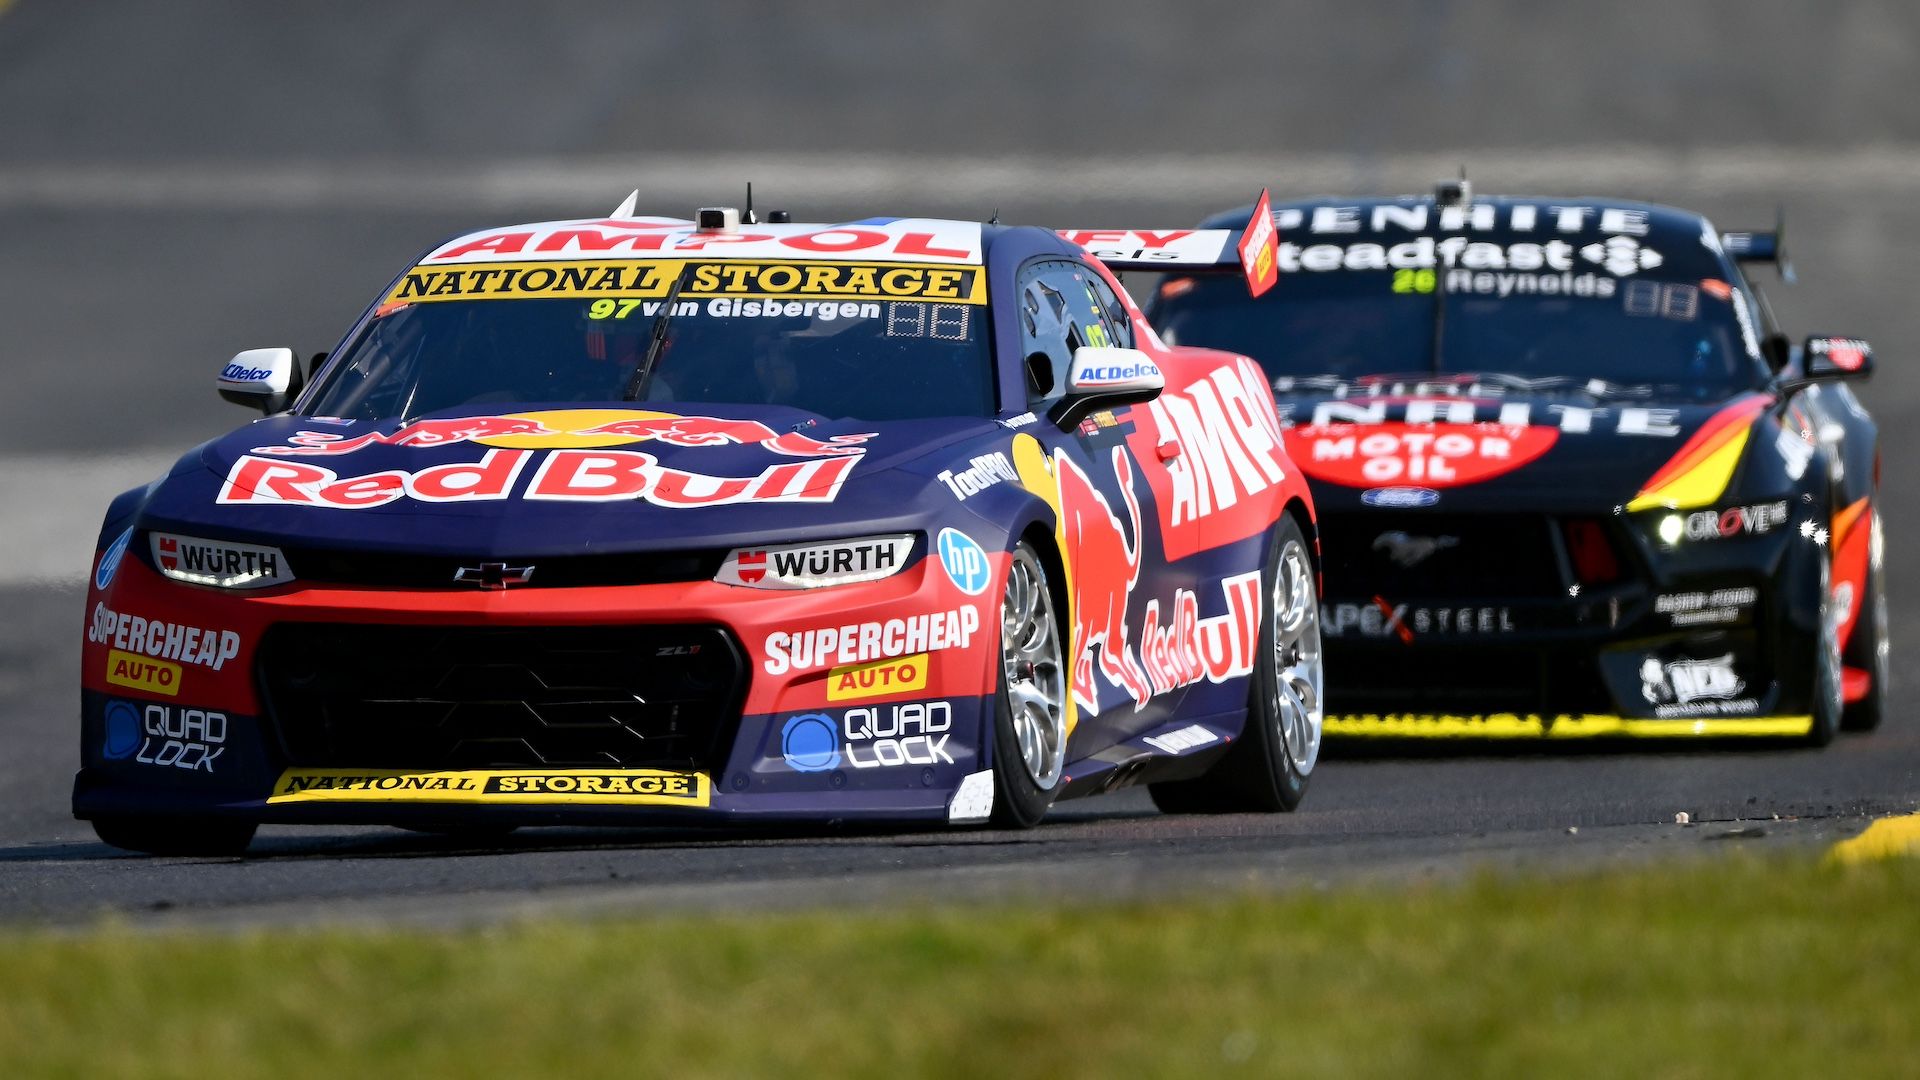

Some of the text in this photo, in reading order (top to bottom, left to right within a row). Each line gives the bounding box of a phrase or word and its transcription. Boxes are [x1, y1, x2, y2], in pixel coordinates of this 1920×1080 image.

[431, 230, 971, 260] AMPOL
[1057, 231, 1196, 247] EY
[398, 265, 962, 298] NATIONAL STORAGE
[1392, 268, 1617, 297] 26 Reynolds
[588, 299, 880, 321] 97 van Gisbergen
[1080, 363, 1159, 380] ACDelco
[1313, 433, 1511, 461] MOTOR
[217, 449, 865, 508] Red Bull
[1362, 455, 1457, 482] OIL
[1686, 507, 1770, 540] GROVE
[181, 544, 278, 578] WÜRTH
[774, 543, 896, 577] WÜRTH
[947, 537, 982, 595] hp
[89, 602, 240, 671] SUPERCHEAP
[1176, 570, 1263, 690] Bull
[1415, 607, 1514, 634] STEEL
[764, 605, 979, 675] SUPERCHEAP
[114, 660, 173, 686] AUTO
[837, 664, 917, 691] AUTO
[145, 705, 227, 743] QUAD
[844, 702, 951, 739] QUAD
[136, 738, 224, 773] LOCK
[845, 734, 954, 768] LOCK
[284, 775, 688, 794] NATIONAL STORAGE
